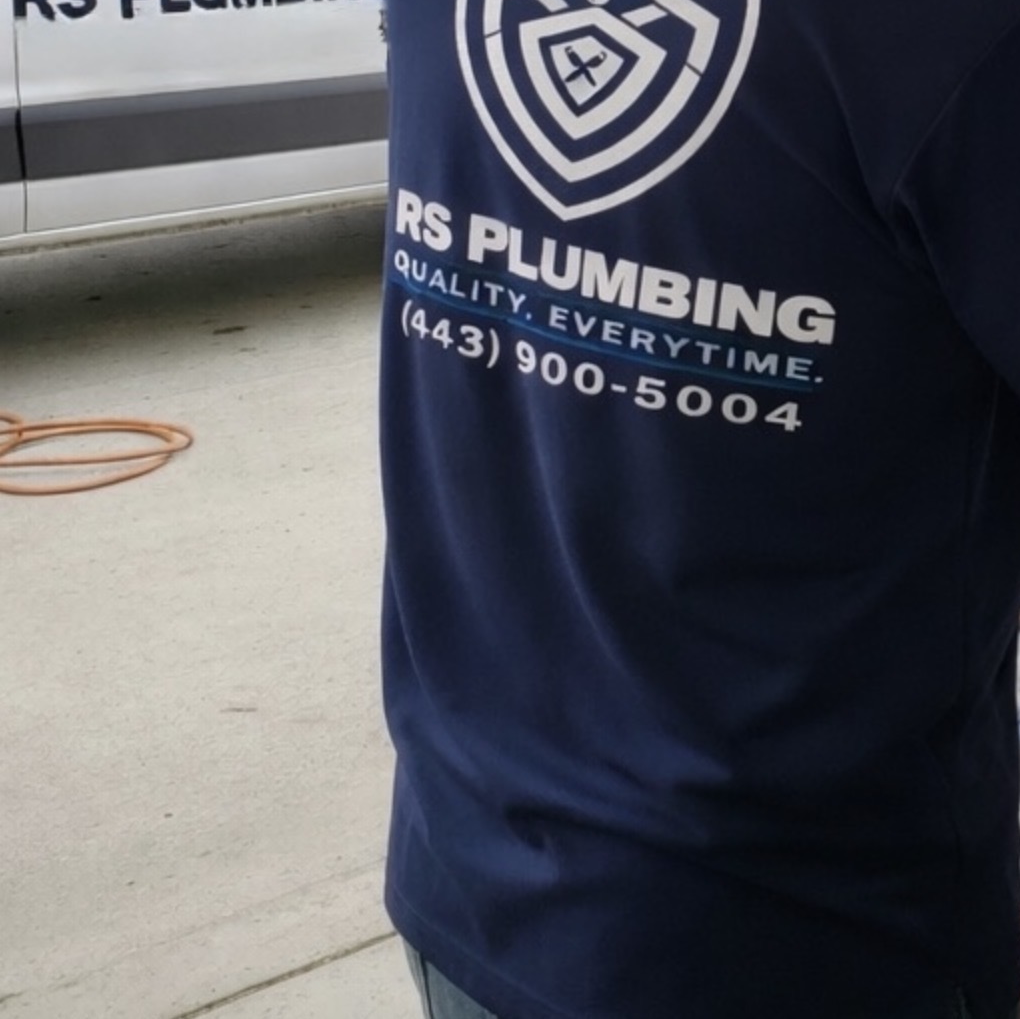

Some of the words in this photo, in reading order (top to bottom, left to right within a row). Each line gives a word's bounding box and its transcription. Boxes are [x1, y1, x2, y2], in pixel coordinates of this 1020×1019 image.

[395, 188, 453, 252] RS
[466, 213, 837, 346] PLUMBING
[400, 298, 501, 369] (443)
[515, 341, 803, 433] 900-5004
[548, 304, 824, 383] EVERYTIME.
